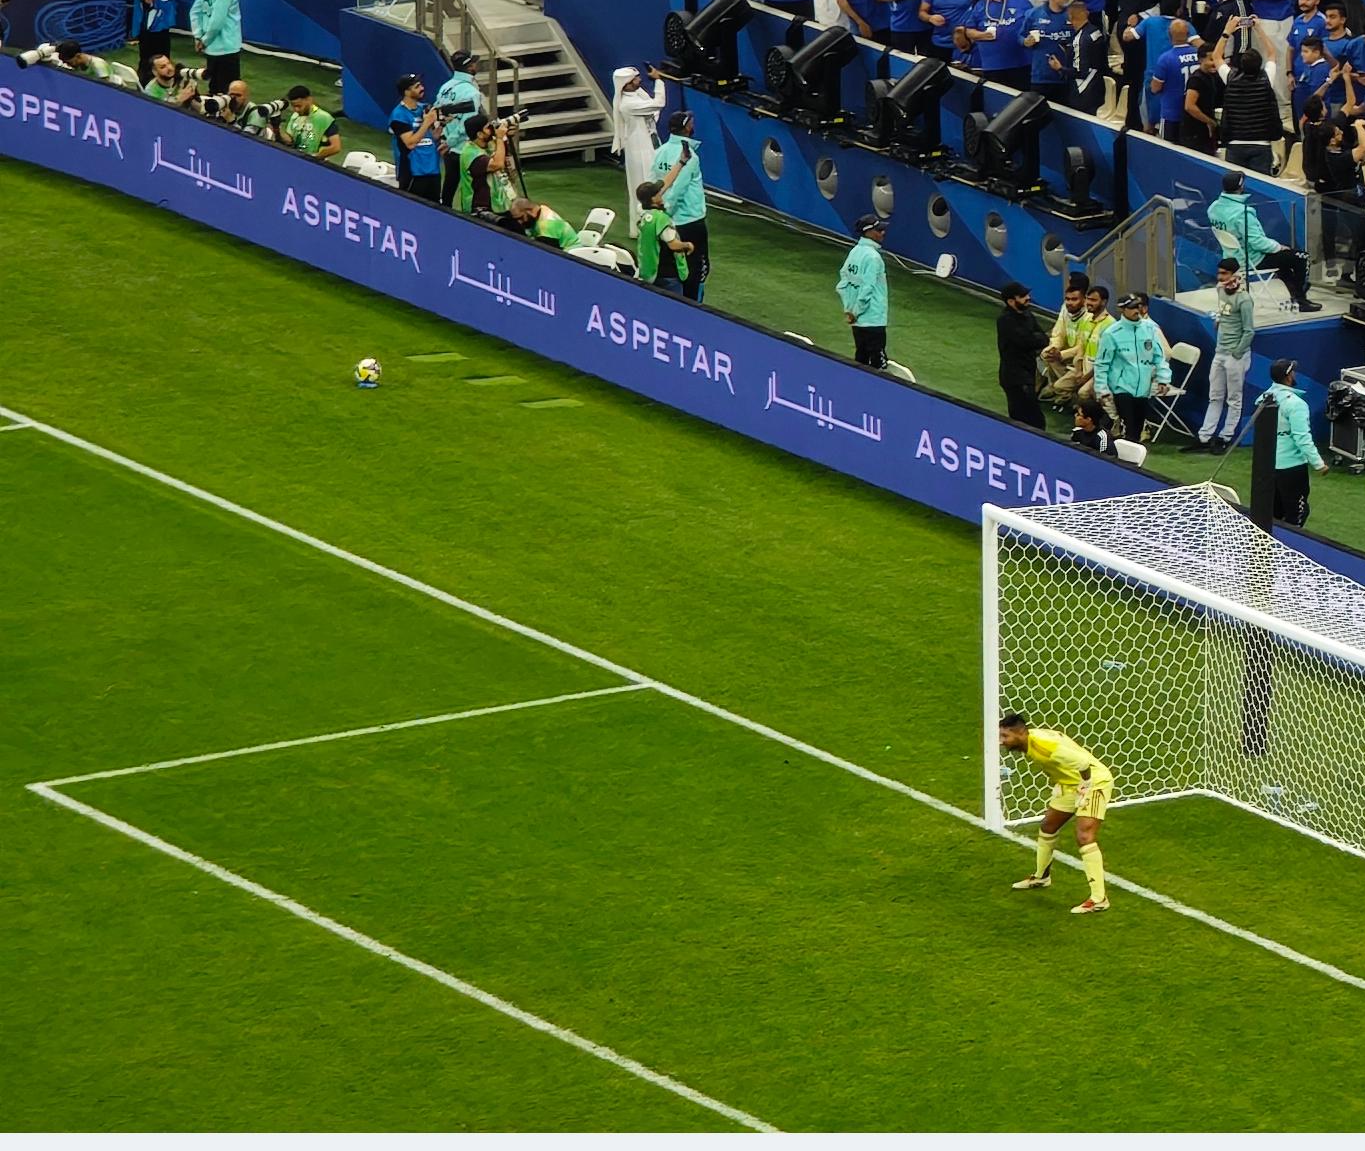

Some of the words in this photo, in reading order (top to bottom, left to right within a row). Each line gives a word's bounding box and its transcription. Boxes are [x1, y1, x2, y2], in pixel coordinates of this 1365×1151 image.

[282, 188, 422, 274] ASPETAR
[586, 304, 735, 396] ASPETAR
[915, 430, 1076, 506] ASPETAR
